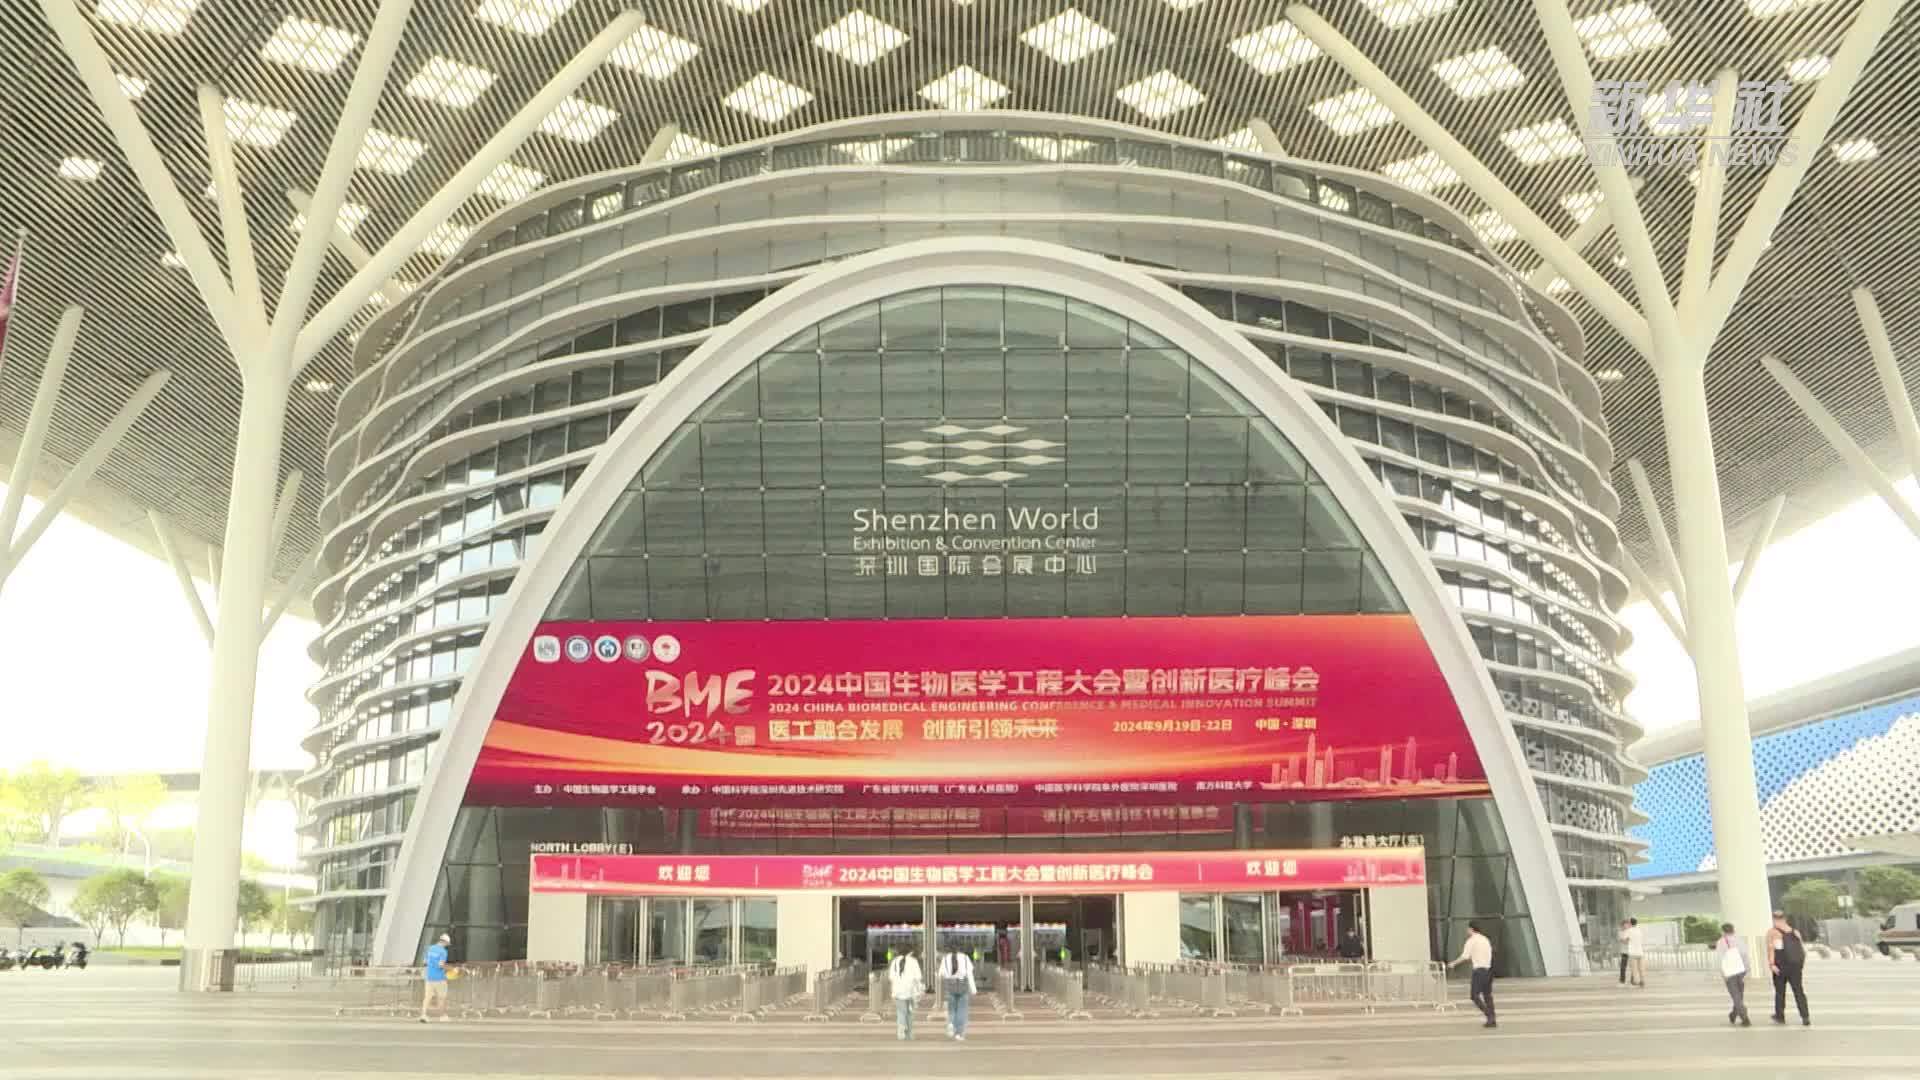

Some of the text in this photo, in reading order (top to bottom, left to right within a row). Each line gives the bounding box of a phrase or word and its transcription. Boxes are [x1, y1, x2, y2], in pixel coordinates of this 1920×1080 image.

[853, 507, 1099, 531] Shenzhen World
[853, 536, 1096, 551] Exhibition & Convention Center
[854, 555, 1097, 576] 深圳国际会展中心
[767, 667, 1320, 698] 2024中国生物医学工程大会暨创新医疗峰会
[645, 669, 756, 718] BME
[768, 702, 799, 713] 2024
[803, 702, 844, 713] CHINA
[848, 702, 926, 713] BIOMEDICAL
[931, 702, 1017, 712] ENGINEERING
[646, 721, 731, 744] 2024
[769, 719, 903, 741] 医工融合发展
[923, 719, 1058, 740] 创新引领未来
[530, 843, 569, 853] NORTH
[658, 865, 711, 881] 欢迎您
[1246, 860, 1297, 876] 欢迎您
